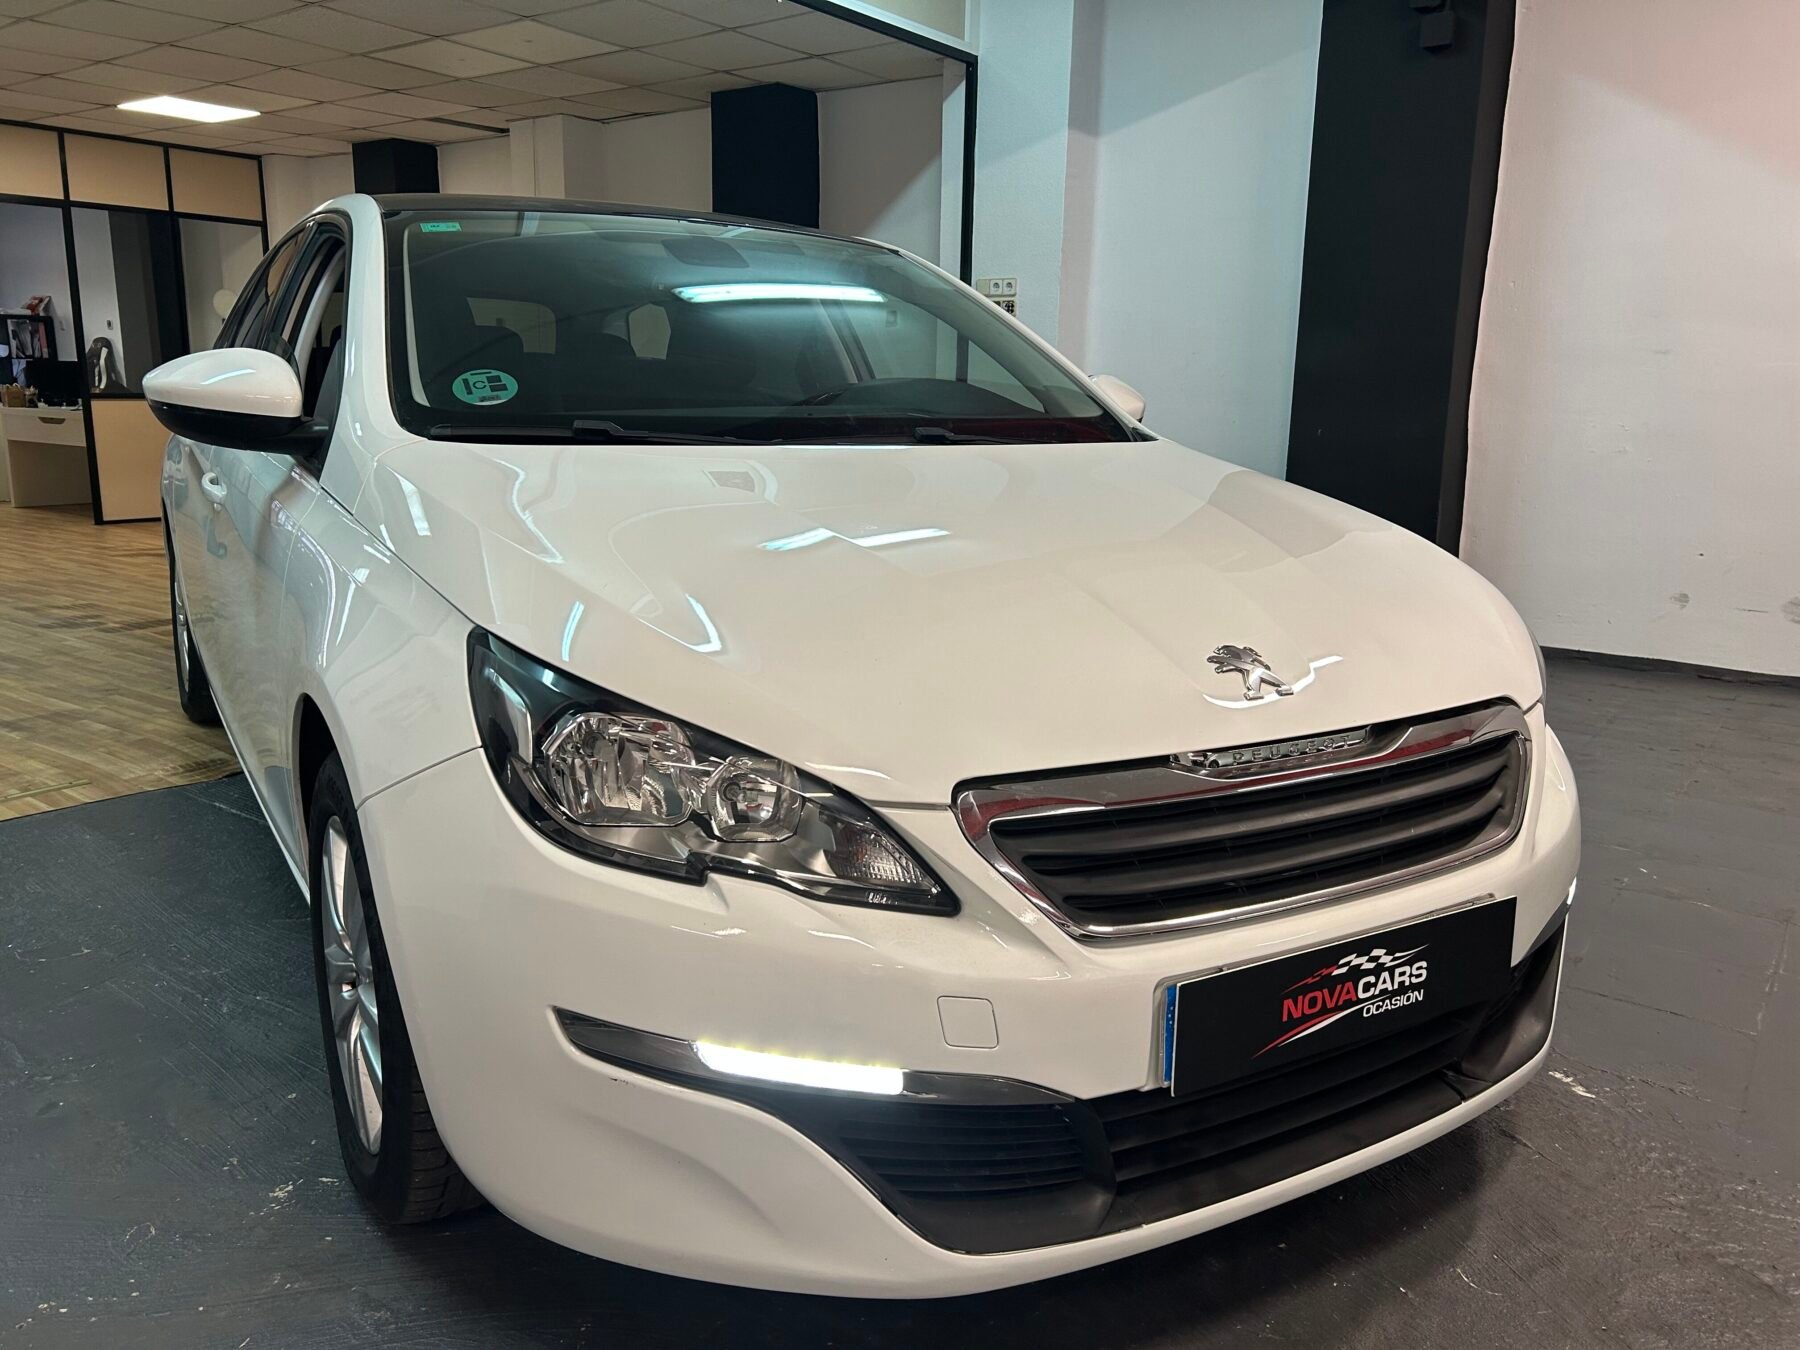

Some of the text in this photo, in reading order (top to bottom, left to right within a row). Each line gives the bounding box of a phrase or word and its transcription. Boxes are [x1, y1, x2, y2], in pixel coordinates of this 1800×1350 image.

[1232, 734, 1350, 766] PEUGEOT
[1282, 960, 1428, 1022] NOVACARS
[1363, 989, 1424, 1018] OCASIÓN
